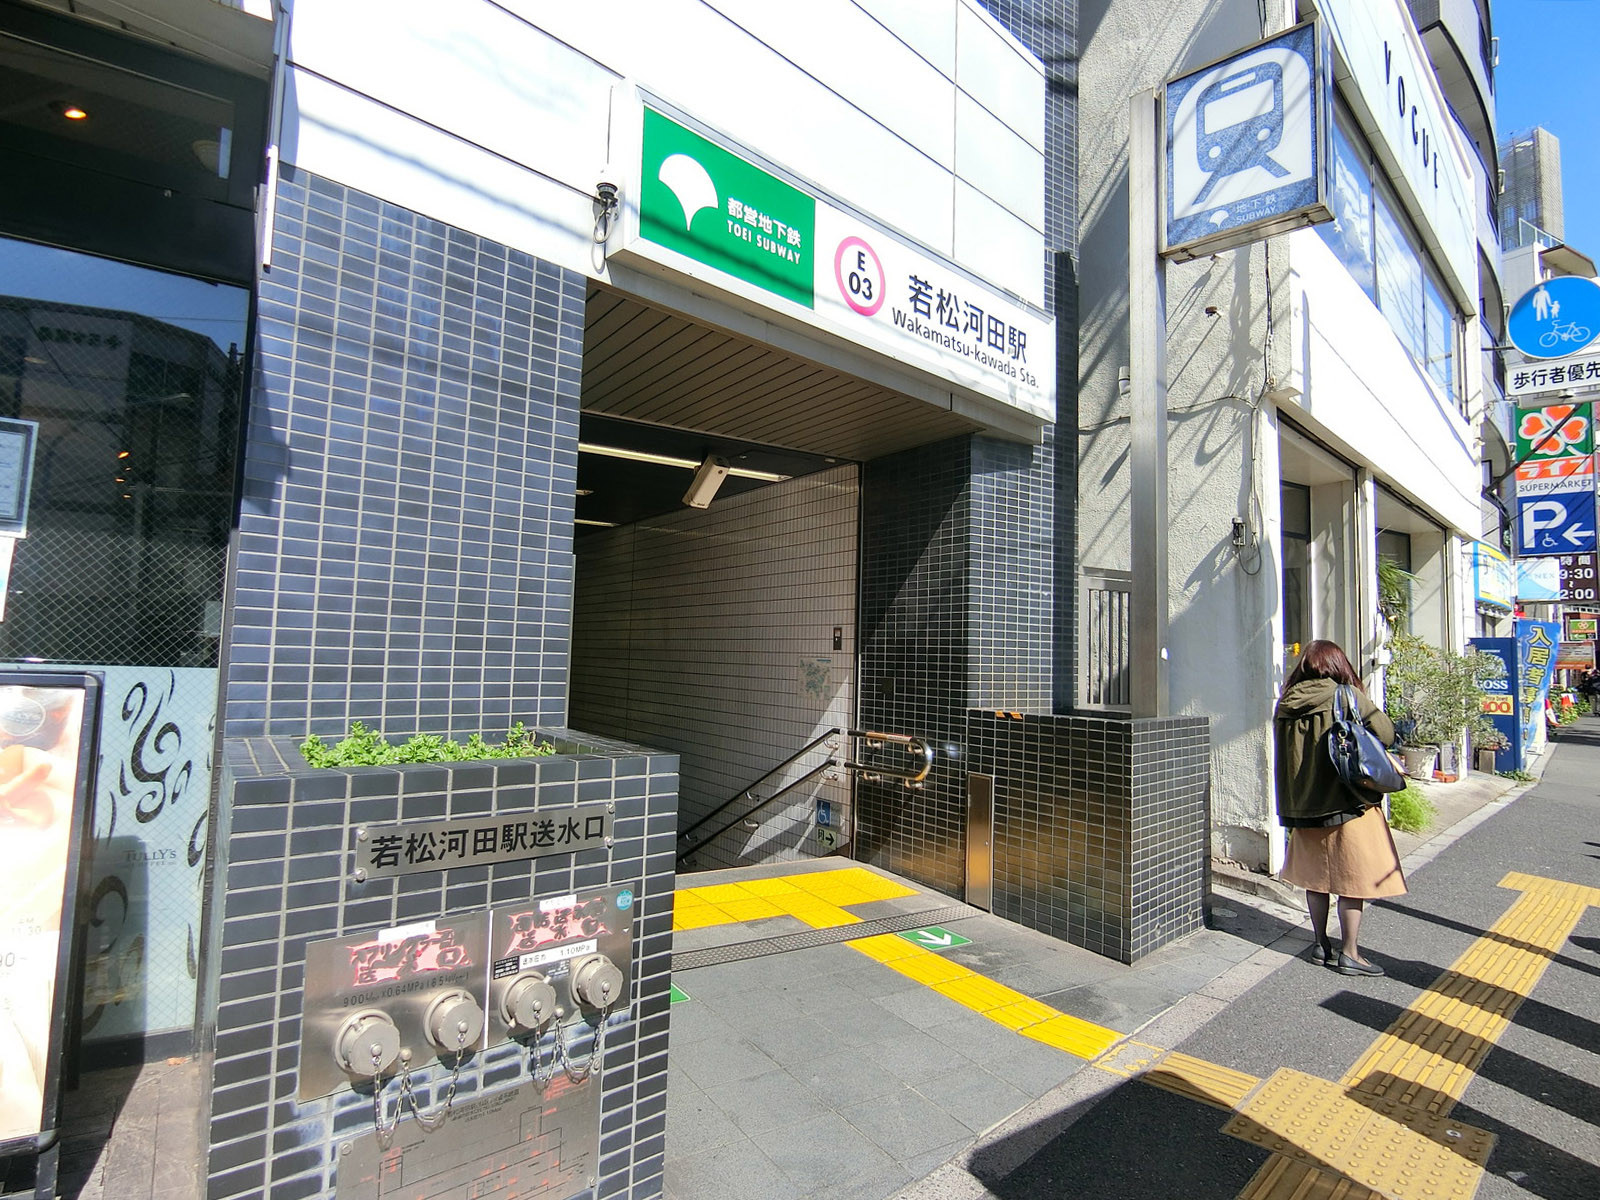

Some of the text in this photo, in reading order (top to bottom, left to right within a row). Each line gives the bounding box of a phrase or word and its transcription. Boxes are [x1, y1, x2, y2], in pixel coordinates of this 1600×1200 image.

[1236, 193, 1277, 213] 地下鉄
[1236, 205, 1276, 224] SUBWAY
[727, 197, 801, 248] 都営地下鉄
[727, 220, 800, 264] TOEI SUBWAY
[857, 251, 866, 272] E
[848, 271, 873, 300] 03
[908, 274, 1027, 364] 若松河田駅
[892, 306, 1039, 388] Wakamatsu-kawada Sta.
[1513, 361, 1600, 389] 歩行者優先
[1519, 458, 1592, 480] ライフ
[1519, 479, 1593, 493] SUPERMARKET
[1522, 501, 1567, 549] P
[370, 815, 605, 868] 若松河田駅送水口
